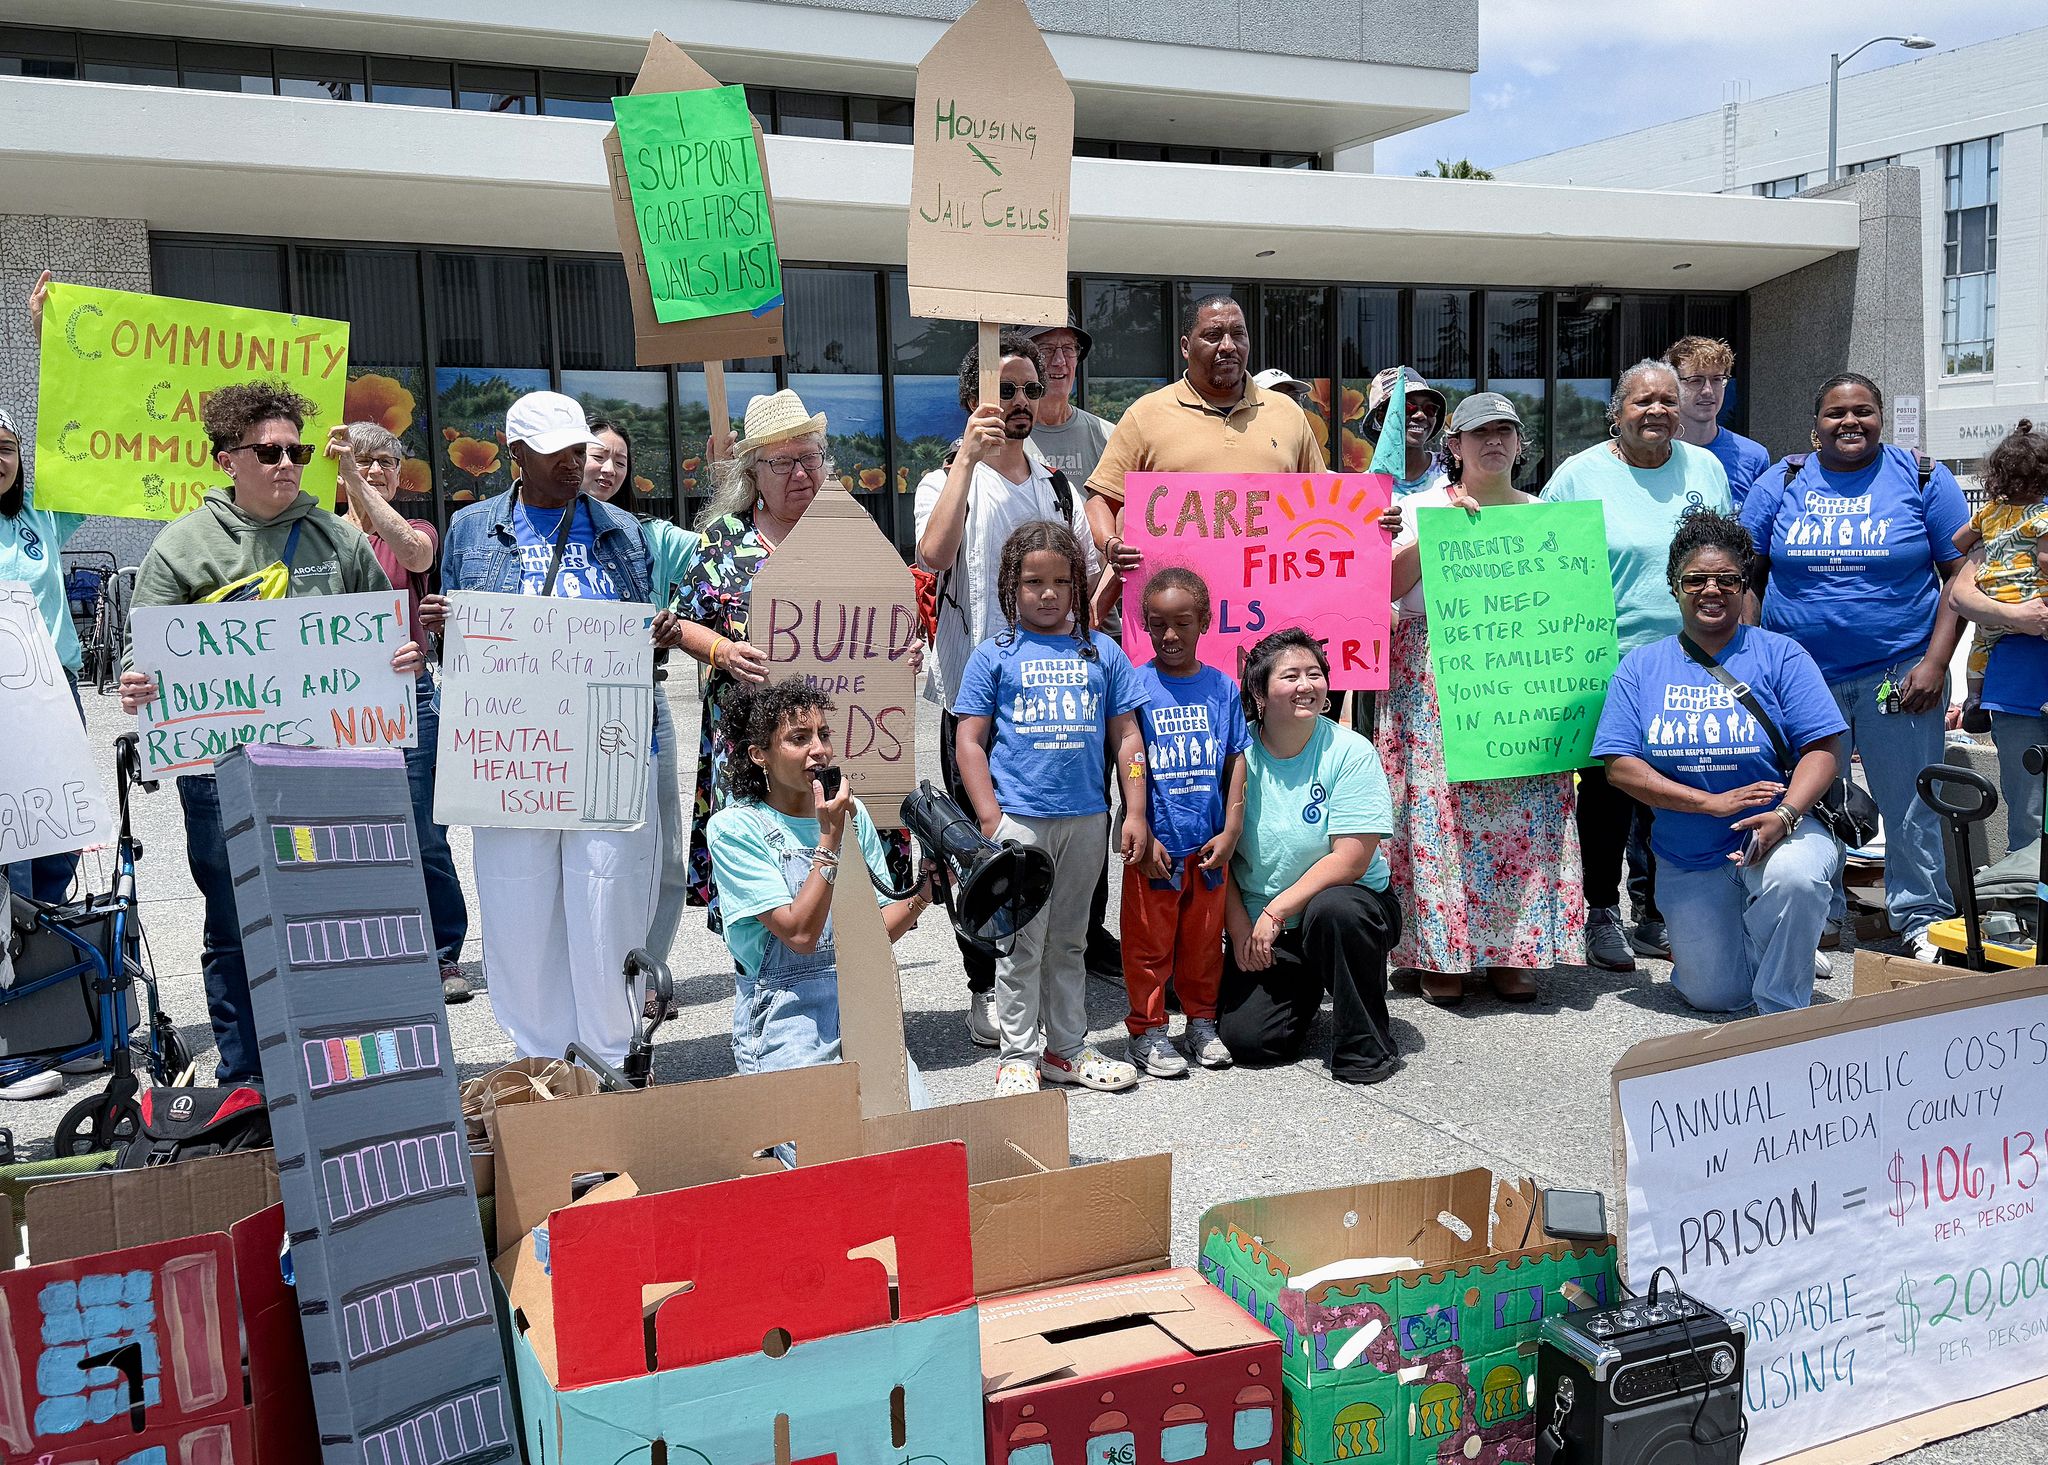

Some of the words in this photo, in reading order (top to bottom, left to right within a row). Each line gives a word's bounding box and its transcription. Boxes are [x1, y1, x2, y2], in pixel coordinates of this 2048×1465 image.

[676, 96, 686, 137] I
[638, 136, 752, 190] SUPPORT
[643, 198, 699, 244] CARE
[704, 190, 765, 238] FIRST
[657, 254, 719, 301] JAILS
[724, 242, 774, 292] LAST
[66, 302, 346, 379] COMMUNITY
[1959, 422, 2004, 439] OAKLAND
[57, 420, 218, 471] COMMU
[1145, 484, 1270, 539] CARE
[1806, 503, 1866, 514] VOICES
[1438, 535, 1525, 561] PARENTS
[293, 566, 316, 575] AROC
[1243, 544, 1354, 588] FIRST
[1442, 557, 1544, 583] PROVIDERS
[1558, 555, 1595, 575] SAY:
[1436, 598, 1471, 620] WE
[1484, 591, 1550, 614] NEED
[166, 618, 276, 656] CARE
[299, 600, 406, 645] FIRST!
[456, 605, 516, 634] 44%
[534, 608, 557, 634] of
[567, 614, 637, 644] people
[769, 598, 916, 662] BUILD
[1444, 621, 1524, 645] BETTER
[1537, 613, 1616, 636] SUPPORT
[453, 657, 470, 673] in
[482, 645, 539, 674] Santa
[552, 649, 593, 676] Rita
[601, 650, 640, 679] Jail
[1024, 660, 1085, 672] PARENT
[1439, 654, 1474, 674] FOR
[1485, 648, 1574, 669] FAMILIES
[1585, 646, 1608, 664] OF
[804, 674, 865, 694] MORE
[1025, 672, 1085, 685] VOICES
[1448, 680, 1512, 704] YOUNG
[1668, 686, 1728, 698] PARENT
[146, 670, 282, 722] HOUSING
[302, 669, 360, 698] AND
[464, 690, 527, 717] have
[558, 698, 575, 715] a
[1668, 696, 1729, 709] VOICES
[331, 684, 413, 747] NOW!
[1155, 707, 1207, 721] PARENT
[1157, 719, 1207, 733] VOICES
[1457, 711, 1482, 731] IN
[1493, 705, 1586, 726] ALAMEDA
[454, 728, 574, 753] MENTAL
[1685, 748, 1704, 756] KEEPS
[474, 759, 567, 783] HEALTH
[501, 789, 577, 814] ISSUE
[1650, 1081, 1785, 1152] ANNUAL
[1808, 1050, 1913, 1108] PUBLIC
[1944, 1022, 2048, 1079] COSTS
[1706, 1148, 1729, 1178] IN
[1754, 1113, 1877, 1165] ALAMEDA
[1907, 1085, 2003, 1131] COUNTY
[1680, 1181, 1817, 1274] PRISON
[1934, 1218, 1966, 1242] PER
[1978, 1198, 2034, 1228] PERSON
[1726, 1274, 1862, 1343] ORDABLE
[1939, 1337, 1972, 1364] PER
[1746, 1335, 1855, 1412] USING
